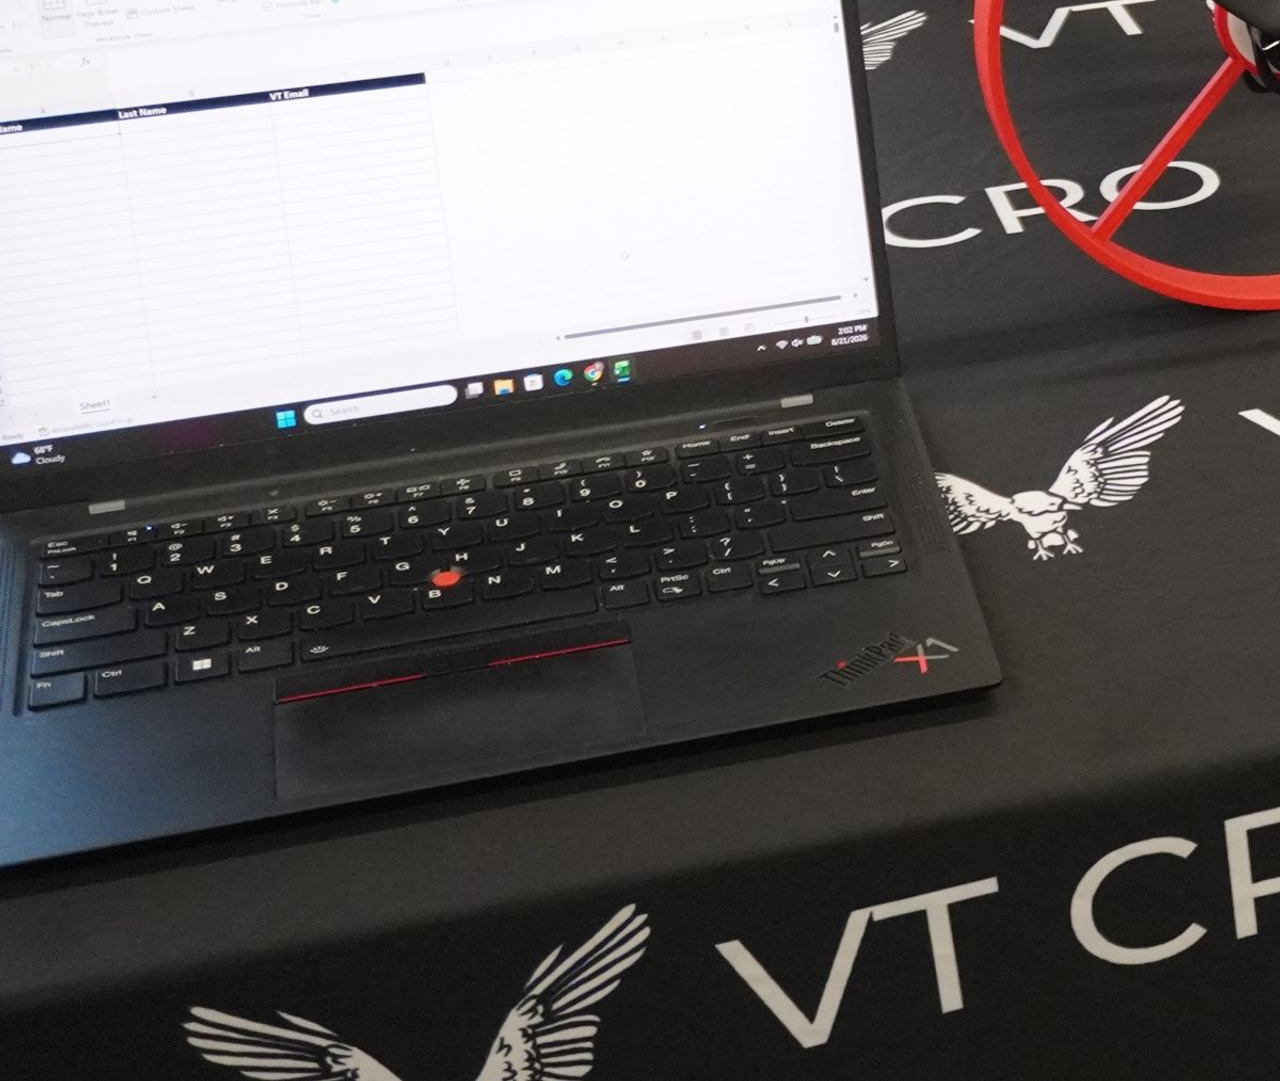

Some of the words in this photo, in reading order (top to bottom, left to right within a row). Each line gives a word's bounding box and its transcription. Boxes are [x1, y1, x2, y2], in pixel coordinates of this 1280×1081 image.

[270, 92, 282, 102] VT
[283, 88, 309, 101] Email
[118, 109, 138, 120] Last
[140, 106, 167, 118] Name
[884, 160, 1220, 248] CRO
[855, 324, 868, 332] PM
[811, 437, 860, 449] Backspace
[36, 454, 66, 465] Cloudy
[852, 487, 875, 495] Enter
[609, 500, 622, 508] O
[466, 506, 476, 514] 7
[350, 525, 360, 533] 5
[571, 534, 583, 542] K
[169, 543, 182, 551] @
[231, 544, 241, 552] 3
[320, 547, 332, 555] R
[516, 543, 525, 551] J
[171, 553, 180, 561] 2
[261, 556, 271, 564] E
[456, 553, 468, 561] H
[197, 566, 214, 574] W
[396, 562, 409, 570] G
[546, 566, 560, 574] M
[137, 576, 151, 584] Q
[337, 572, 347, 580] F
[488, 576, 500, 584] N
[276, 582, 288, 590] D
[609, 583, 625, 592] Alt
[215, 592, 226, 600] S
[429, 590, 441, 598] B
[307, 606, 320, 614] C
[41, 615, 94, 627] CapsLock
[246, 616, 257, 624] X
[184, 626, 195, 635] Z
[892, 638, 959, 674] X1
[716, 877, 998, 1048] VT
